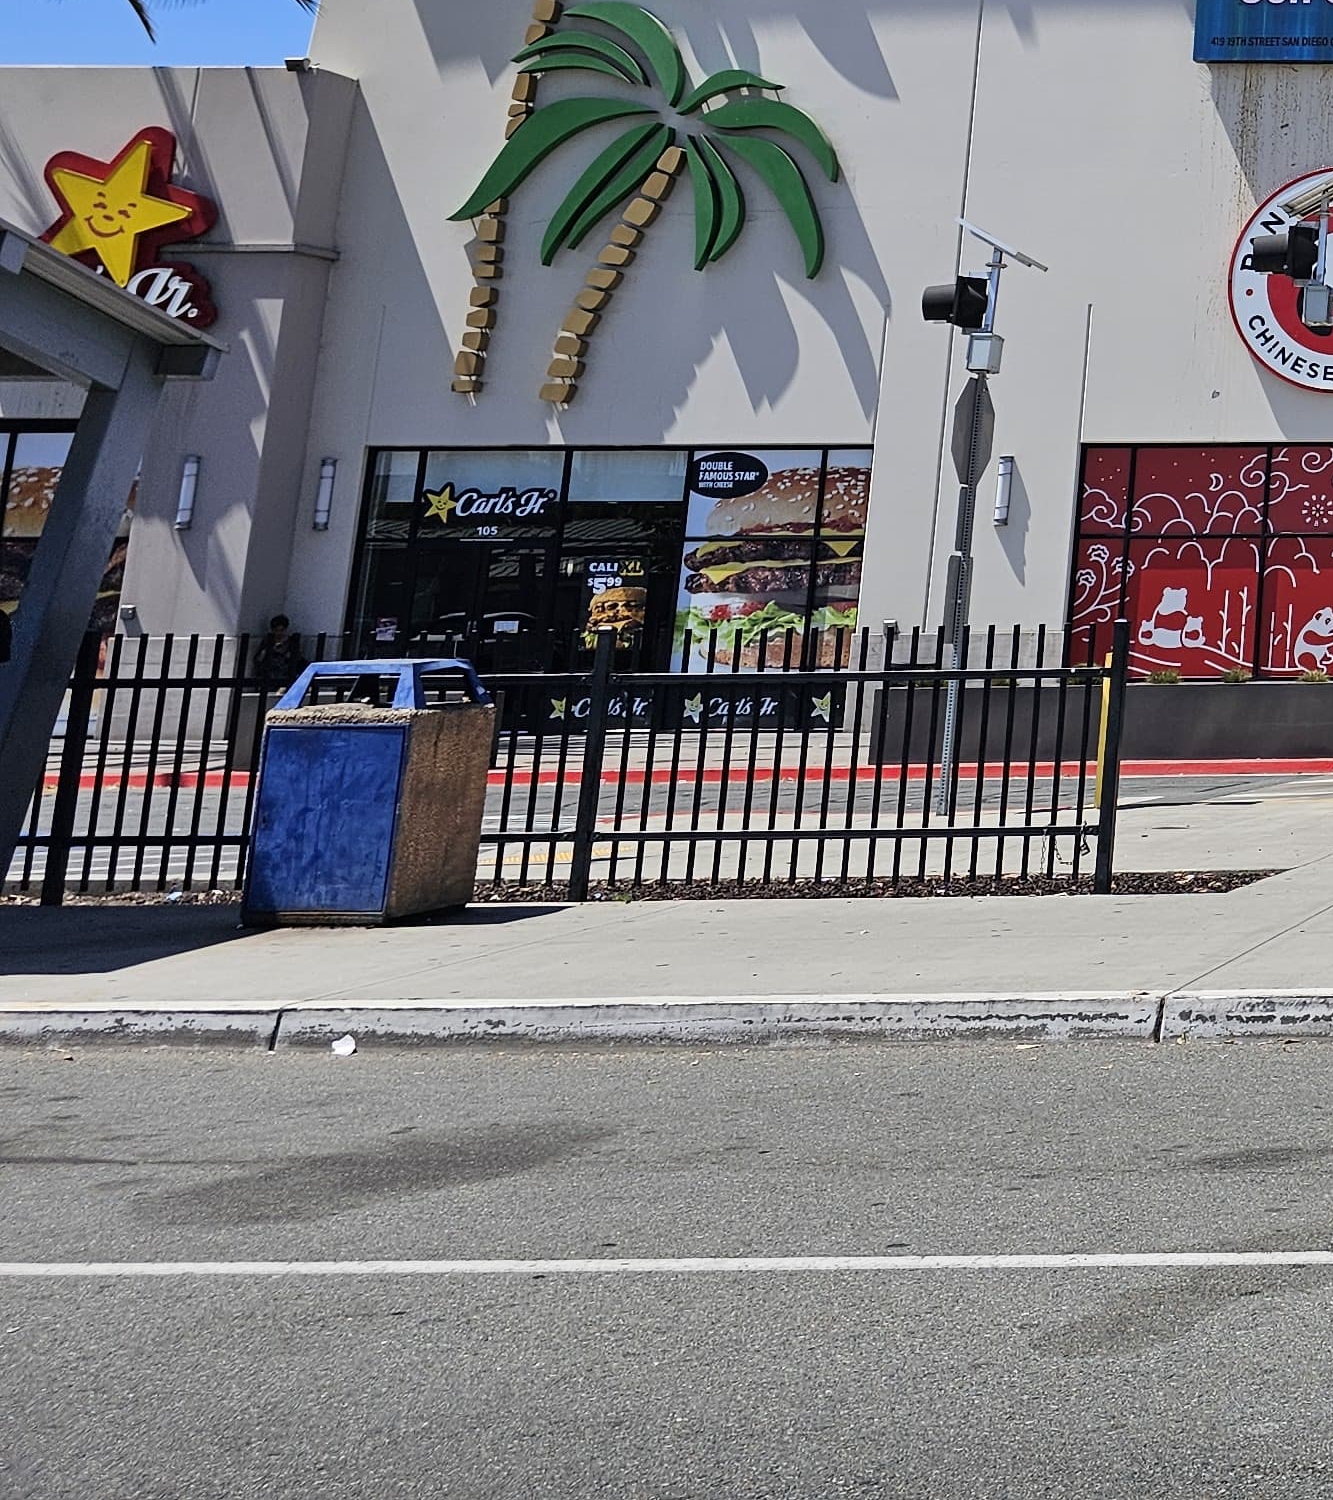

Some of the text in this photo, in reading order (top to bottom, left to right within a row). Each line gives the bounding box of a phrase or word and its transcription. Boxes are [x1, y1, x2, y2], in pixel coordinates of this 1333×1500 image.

[1249, 36, 1281, 47] STREET
[1281, 36, 1300, 47] SAN
[1301, 37, 1329, 47] DIEGO
[700, 461, 734, 471] DOUBLE
[698, 471, 734, 481] FAMOUS
[455, 491, 517, 517] Carl's
[476, 525, 499, 536] 105
[588, 560, 645, 577] CALI XL
